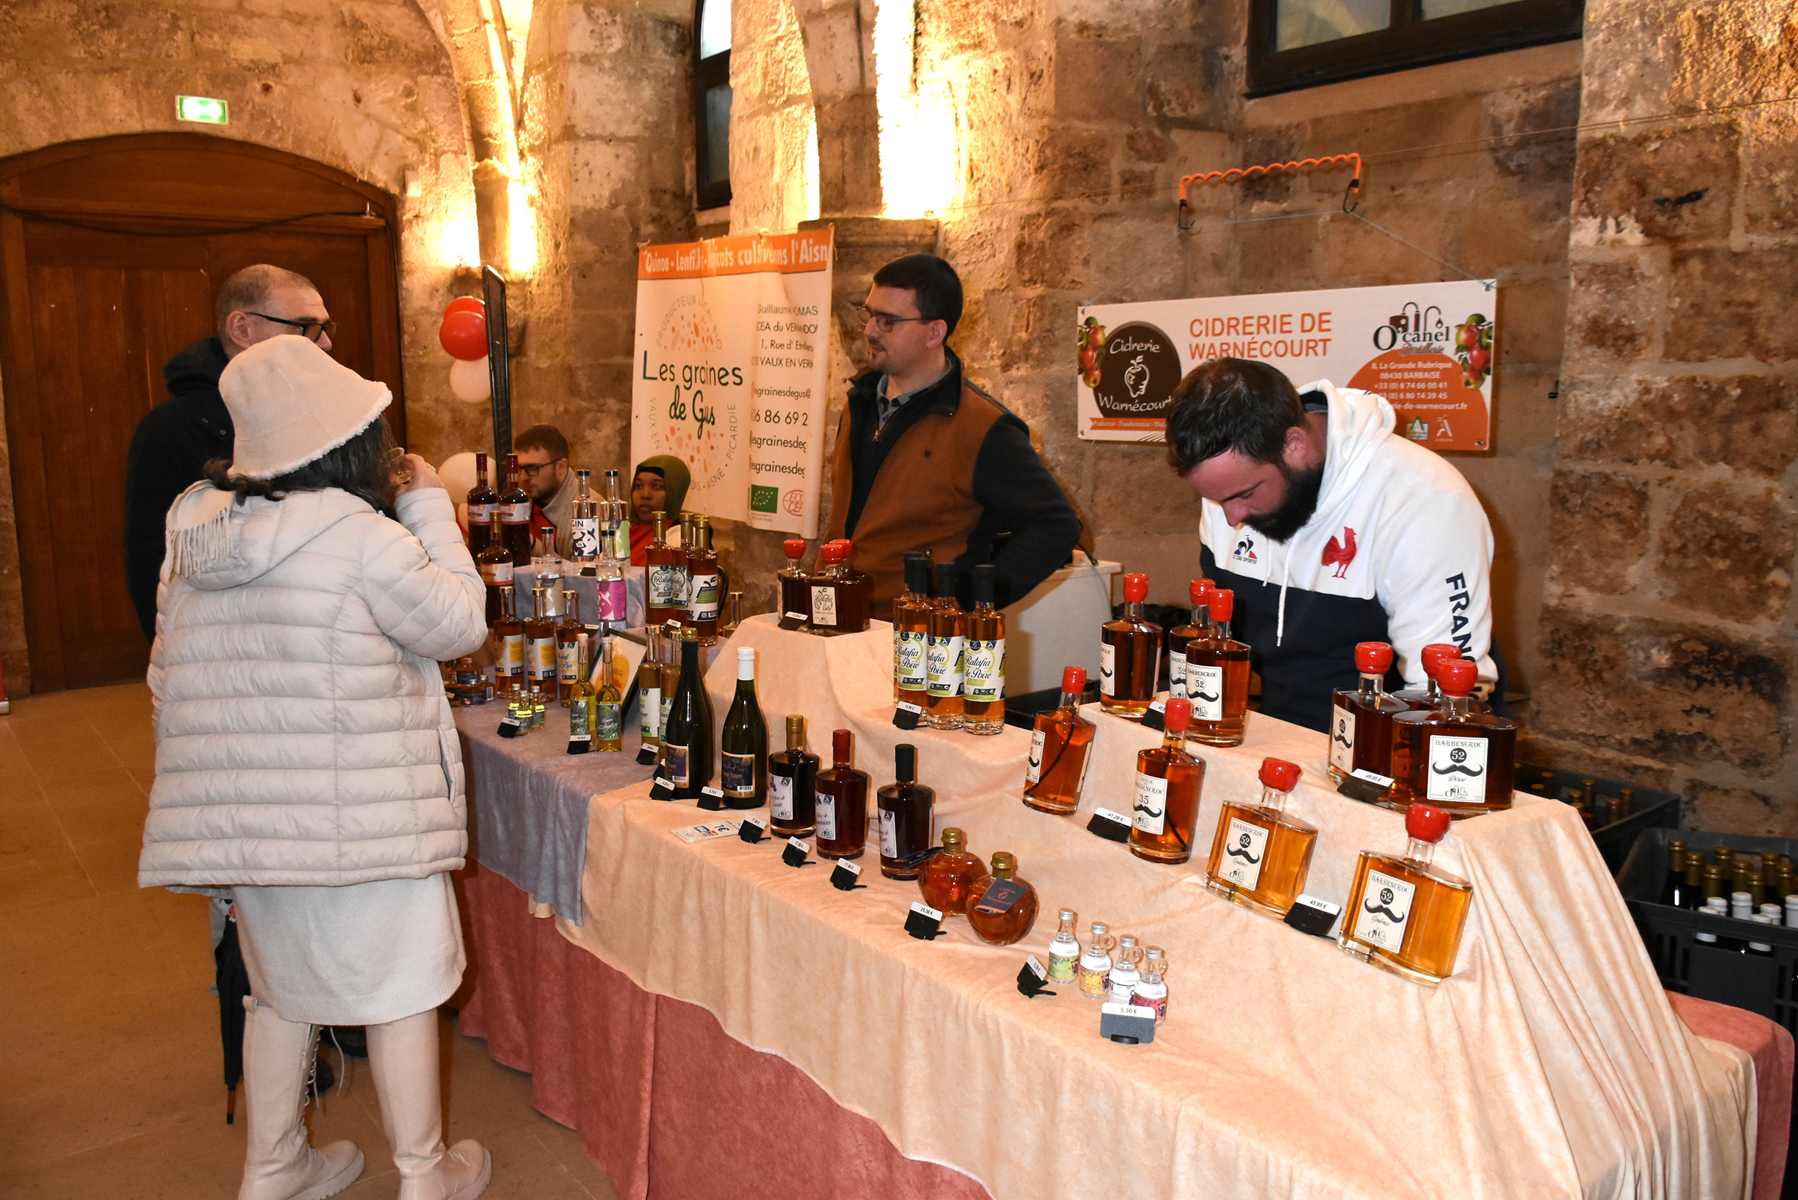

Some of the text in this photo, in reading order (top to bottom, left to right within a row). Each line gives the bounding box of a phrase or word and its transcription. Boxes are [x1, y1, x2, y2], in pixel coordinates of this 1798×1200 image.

[1188, 311, 1332, 338] CIDRERIE DE
[1109, 335, 1161, 355] Cidrerie
[1188, 336, 1332, 360] WARNÉCOURT
[642, 350, 744, 391] Les graines
[668, 385, 687, 421] de
[691, 389, 716, 440] Gus
[764, 409, 781, 424] 86
[784, 411, 799, 425] 69
[801, 412, 809, 426] 2
[1445, 572, 1477, 662] FRAN
[1451, 750, 1466, 761] 52
[1380, 889, 1393, 903] 52
